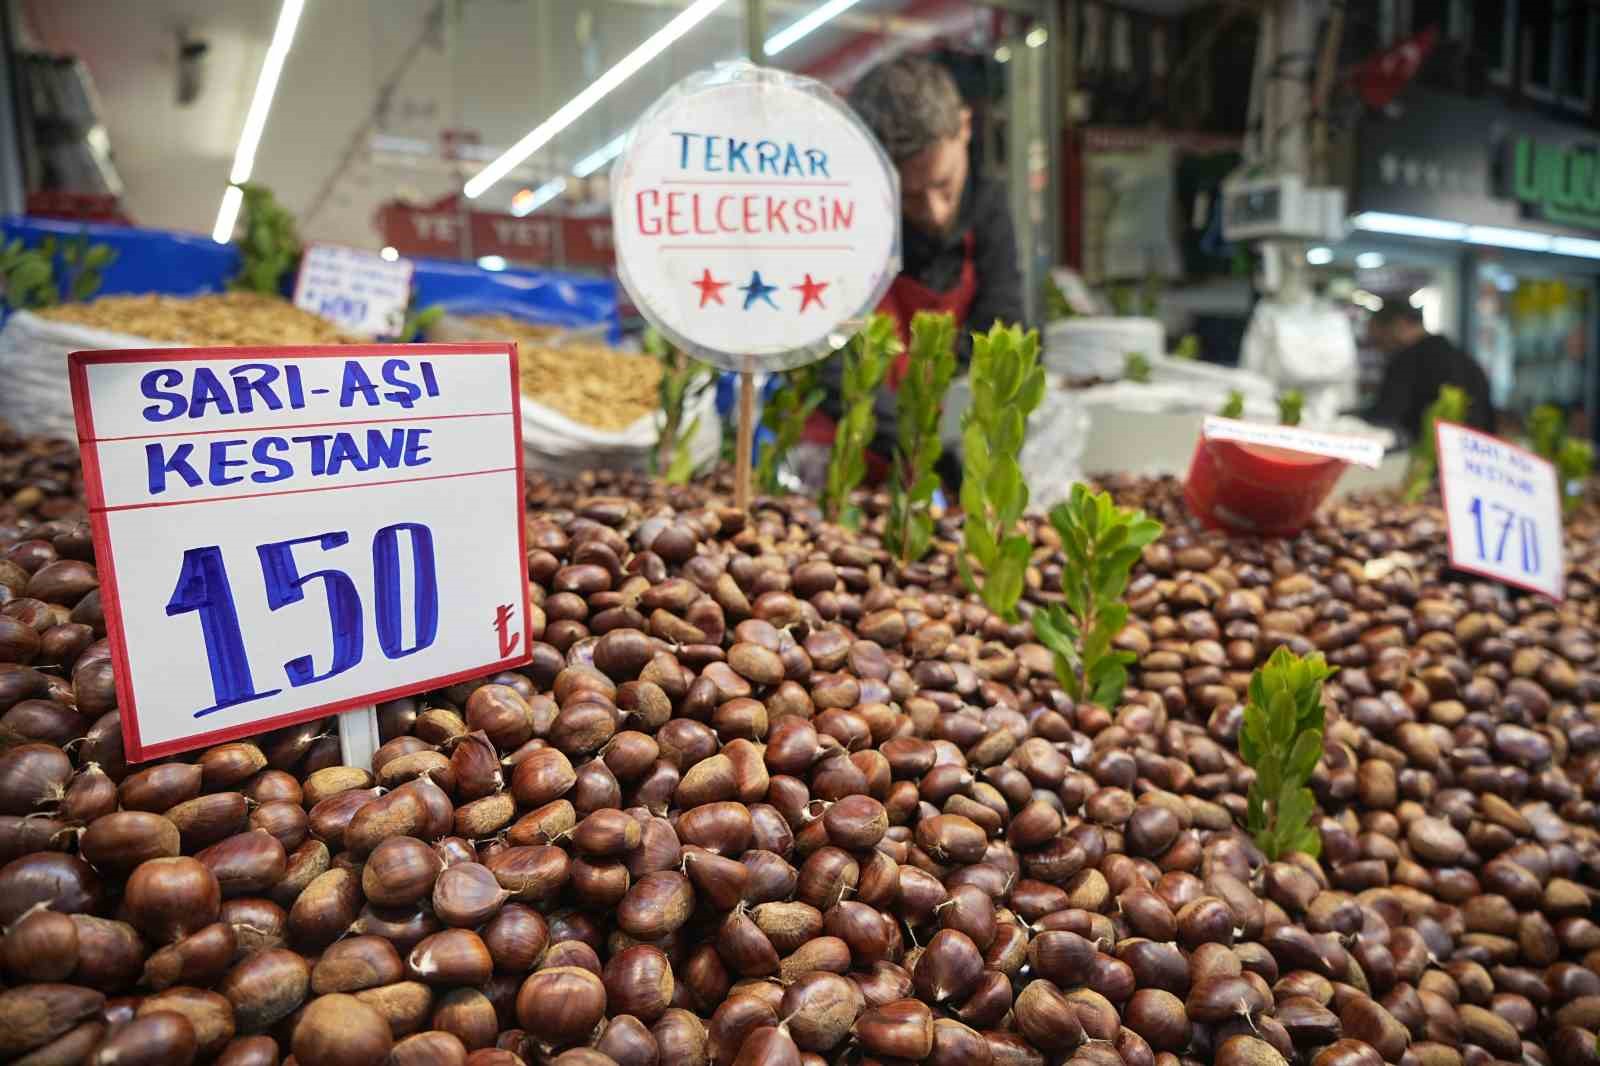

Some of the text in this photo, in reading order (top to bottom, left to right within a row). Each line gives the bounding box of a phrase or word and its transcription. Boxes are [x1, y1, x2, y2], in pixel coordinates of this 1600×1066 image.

[671, 131, 831, 178] TEKRAR
[140, 358, 440, 422] SARI-AŞI
[145, 427, 433, 495] KESTANE
[1467, 496, 1541, 576] 170
[165, 521, 440, 719] 150
